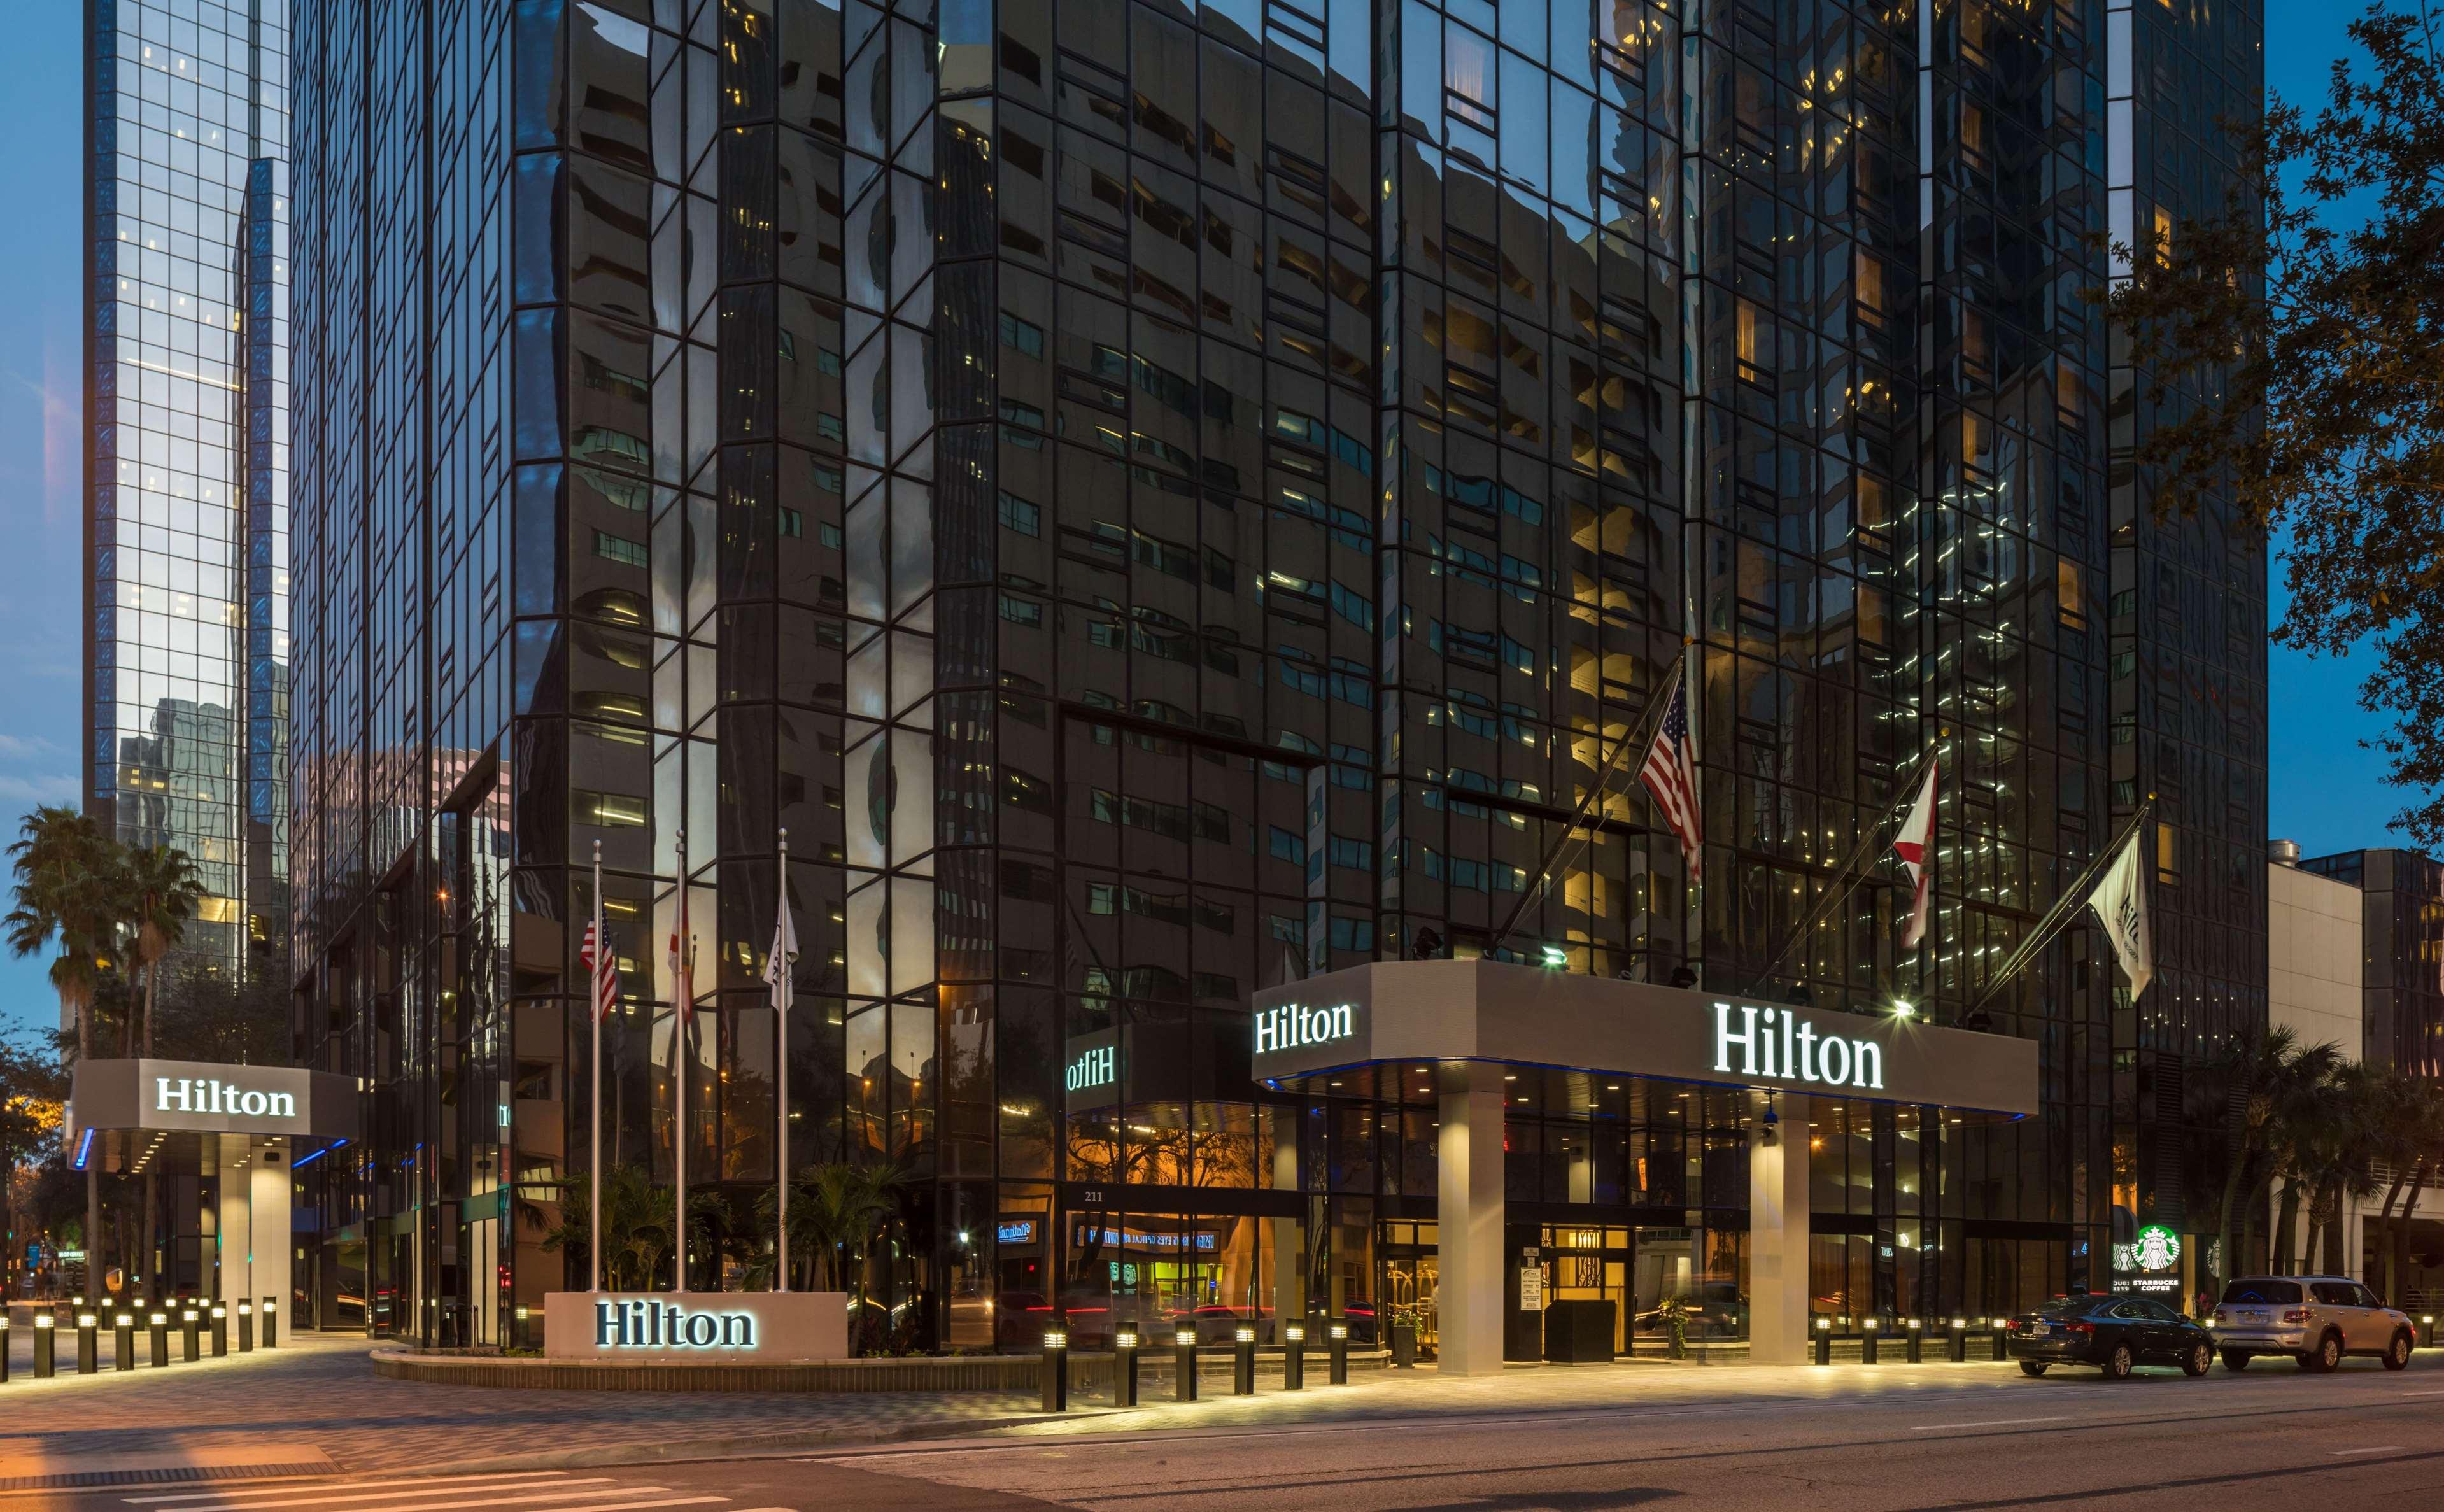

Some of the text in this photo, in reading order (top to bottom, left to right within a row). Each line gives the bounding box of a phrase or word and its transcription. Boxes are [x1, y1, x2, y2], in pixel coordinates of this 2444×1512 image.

[1256, 1003, 1352, 1054] Hilton
[1714, 1002, 1884, 1089] Hilton
[156, 1078, 295, 1117] Hilton
[1085, 1191, 1103, 1202] 211
[595, 1301, 755, 1346] Hilton
